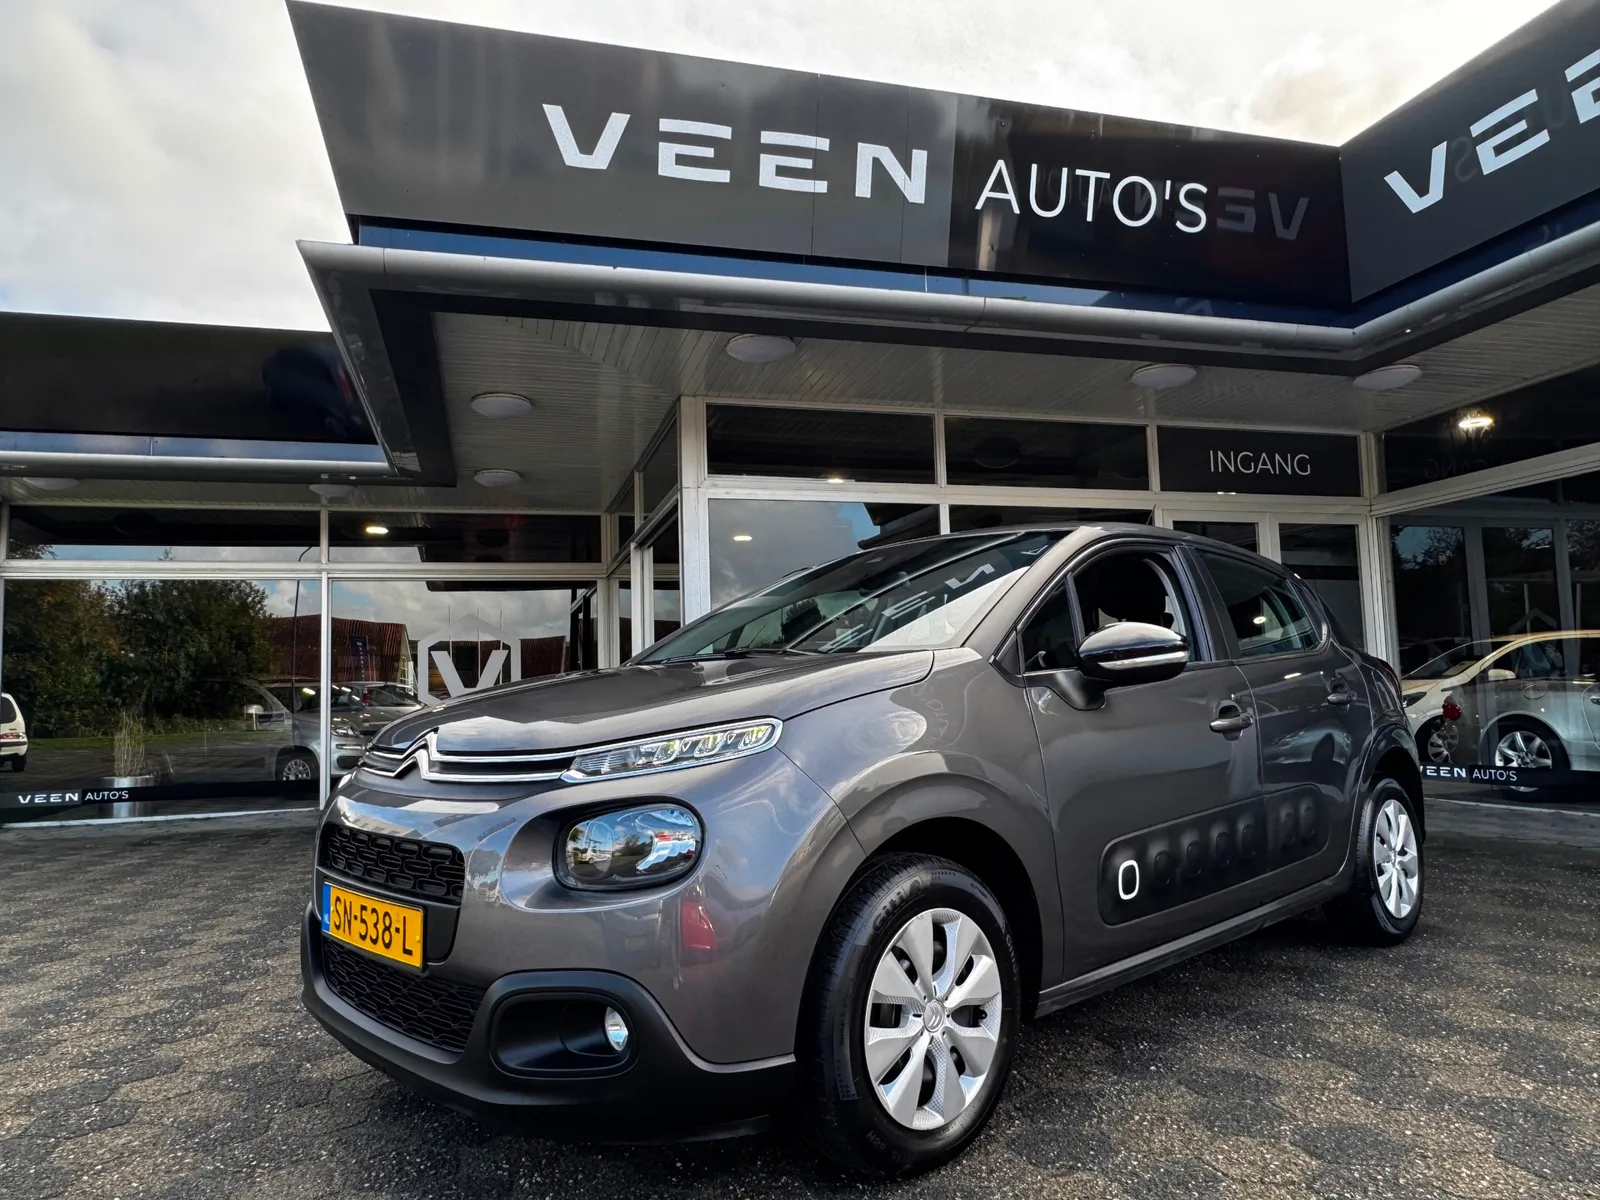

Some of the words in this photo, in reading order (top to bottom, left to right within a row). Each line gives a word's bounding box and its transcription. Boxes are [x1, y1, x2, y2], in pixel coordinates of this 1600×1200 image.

[541, 103, 928, 204] VEEN
[975, 159, 1208, 236] AUTO'S
[1209, 450, 1311, 476] INGANG
[1472, 768, 1518, 782] AUTO'S
[18, 793, 79, 804] VEEN
[84, 790, 130, 801] AUTO'S
[333, 895, 413, 957] SN-538-L
